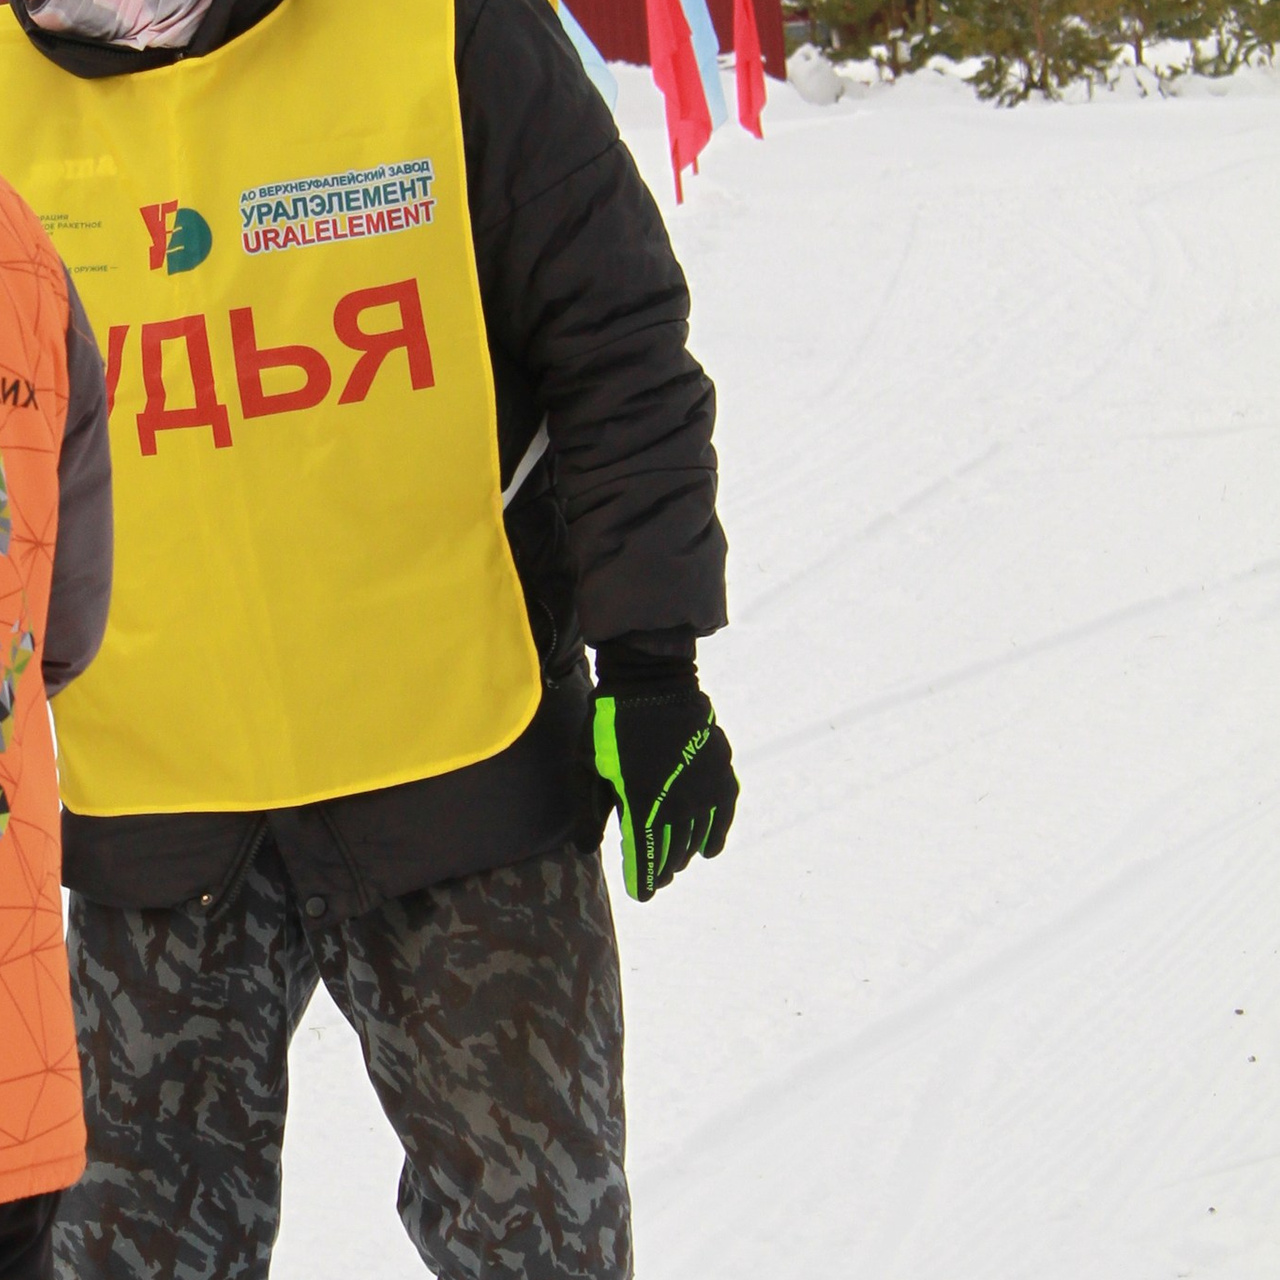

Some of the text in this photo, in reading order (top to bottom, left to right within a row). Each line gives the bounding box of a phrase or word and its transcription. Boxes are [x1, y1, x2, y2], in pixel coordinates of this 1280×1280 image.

[240, 160, 431, 204] АО ВЕРХНЕУФАЛЕЙСКИЙ ЗАВОД
[240, 176, 433, 228] УРАЛЭЛЕМЕНТ
[242, 200, 435, 254] URALELEMENT
